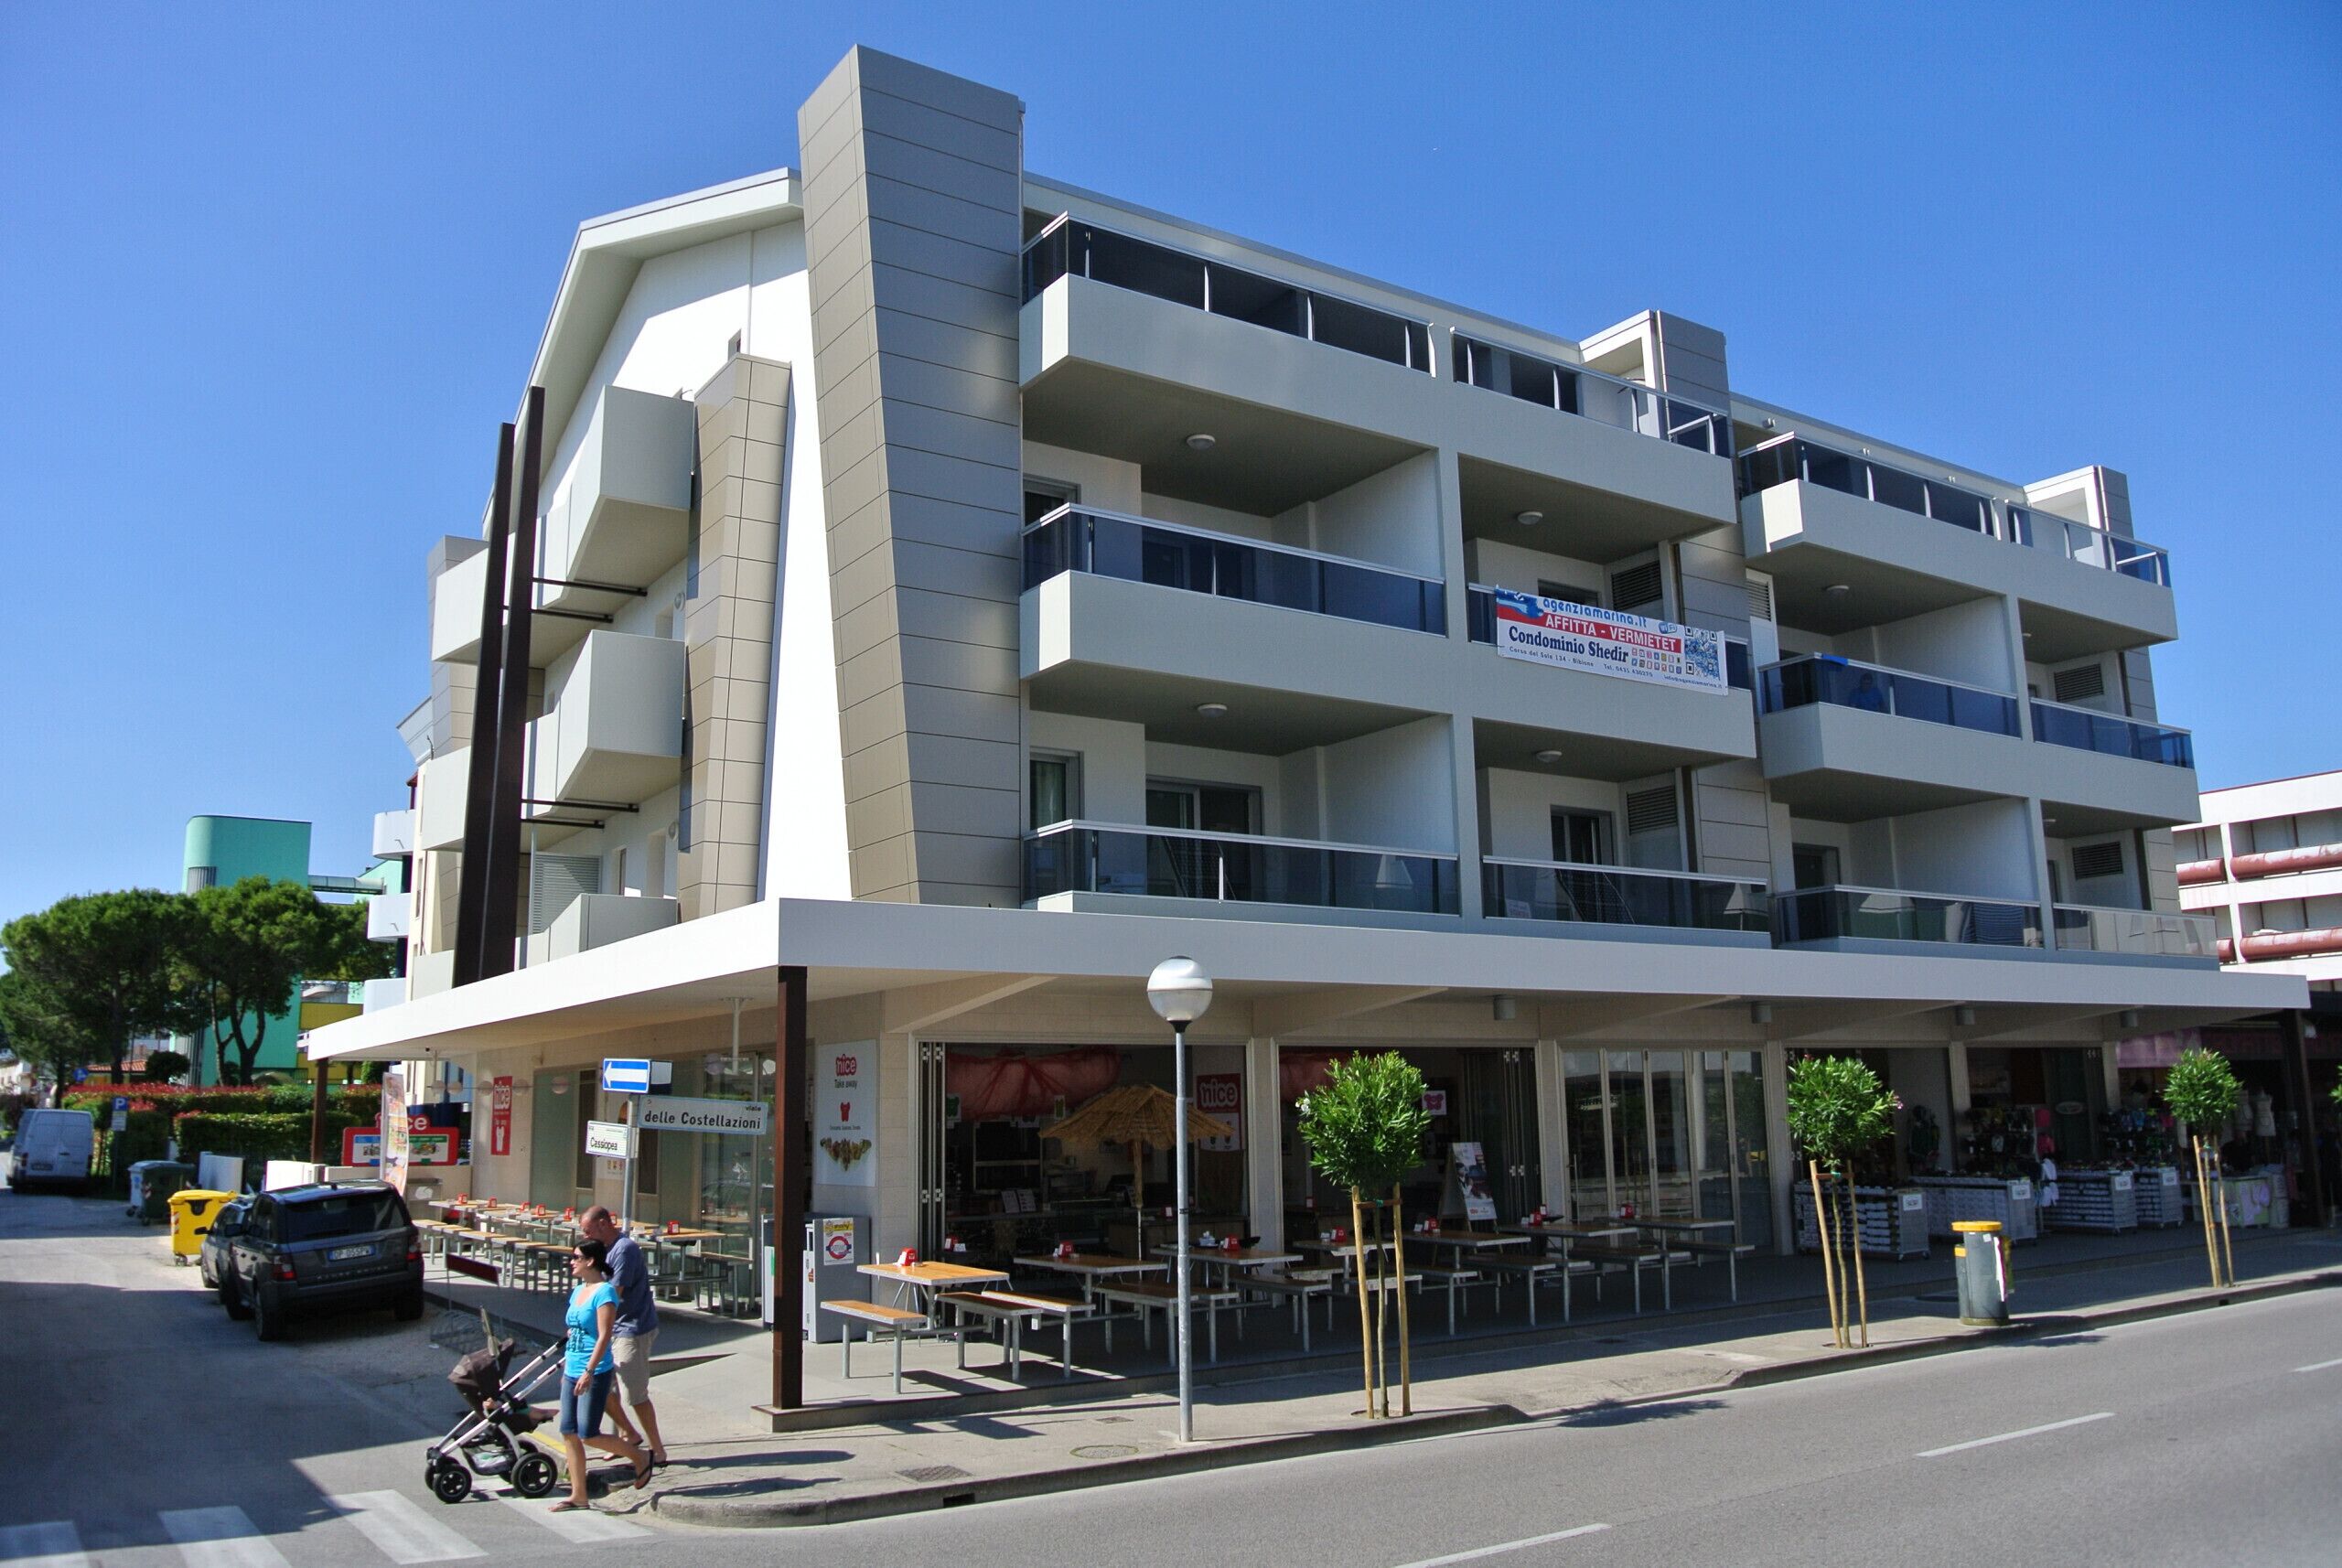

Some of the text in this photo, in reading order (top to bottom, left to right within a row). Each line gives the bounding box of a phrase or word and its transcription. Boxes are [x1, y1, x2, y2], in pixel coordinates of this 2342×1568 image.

[1542, 597, 1647, 628] agenziamarina.it
[1509, 625, 1629, 663] Condominio Shedir
[1545, 615, 1596, 637] AFFITTA
[1609, 626, 1676, 651] VERMIETET
[1509, 646, 1527, 655] Corso
[1529, 650, 1539, 658] del
[836, 1054, 856, 1076] nice
[115, 1098, 125, 1110] P
[1200, 1079, 1238, 1107] nice
[644, 1111, 761, 1130] delle Costellazioni
[590, 1136, 618, 1153] Cassiopea
